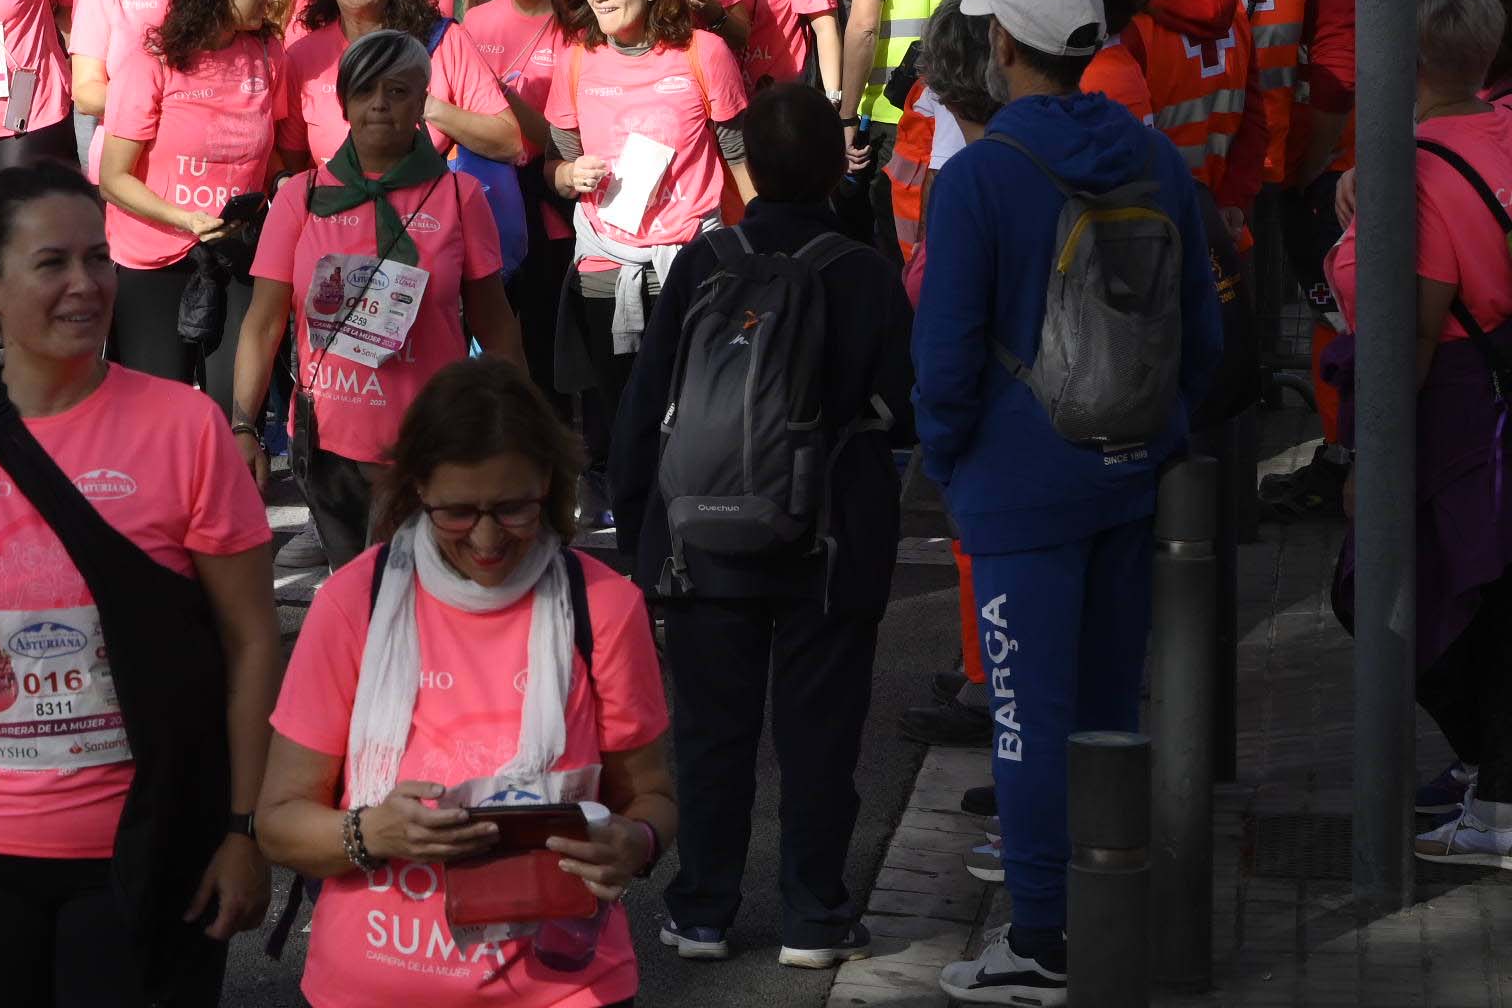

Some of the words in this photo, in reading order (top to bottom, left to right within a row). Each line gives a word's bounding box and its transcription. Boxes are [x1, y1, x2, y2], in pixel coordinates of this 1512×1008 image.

[175, 155, 207, 177] TU
[394, 277, 417, 289] SUMA
[351, 328, 359, 336] LA
[359, 331, 381, 344] MUJER
[306, 361, 384, 397] SUMA
[370, 398, 386, 407] 2023
[1104, 454, 1128, 466] SINCE
[698, 504, 740, 512] Quechua
[15, 633, 83, 651] ASTURIANA
[23, 669, 83, 696] 016
[982, 593, 1023, 762] BARÇA
[36, 700, 73, 717] 8311
[36, 722, 51, 733] DE
[54, 721, 69, 732] LA
[70, 718, 106, 730] MUJER
[366, 950, 405, 968] CARRERA
[407, 960, 419, 972] DE
[421, 963, 435, 974] LA
[436, 965, 471, 978] MUJER
